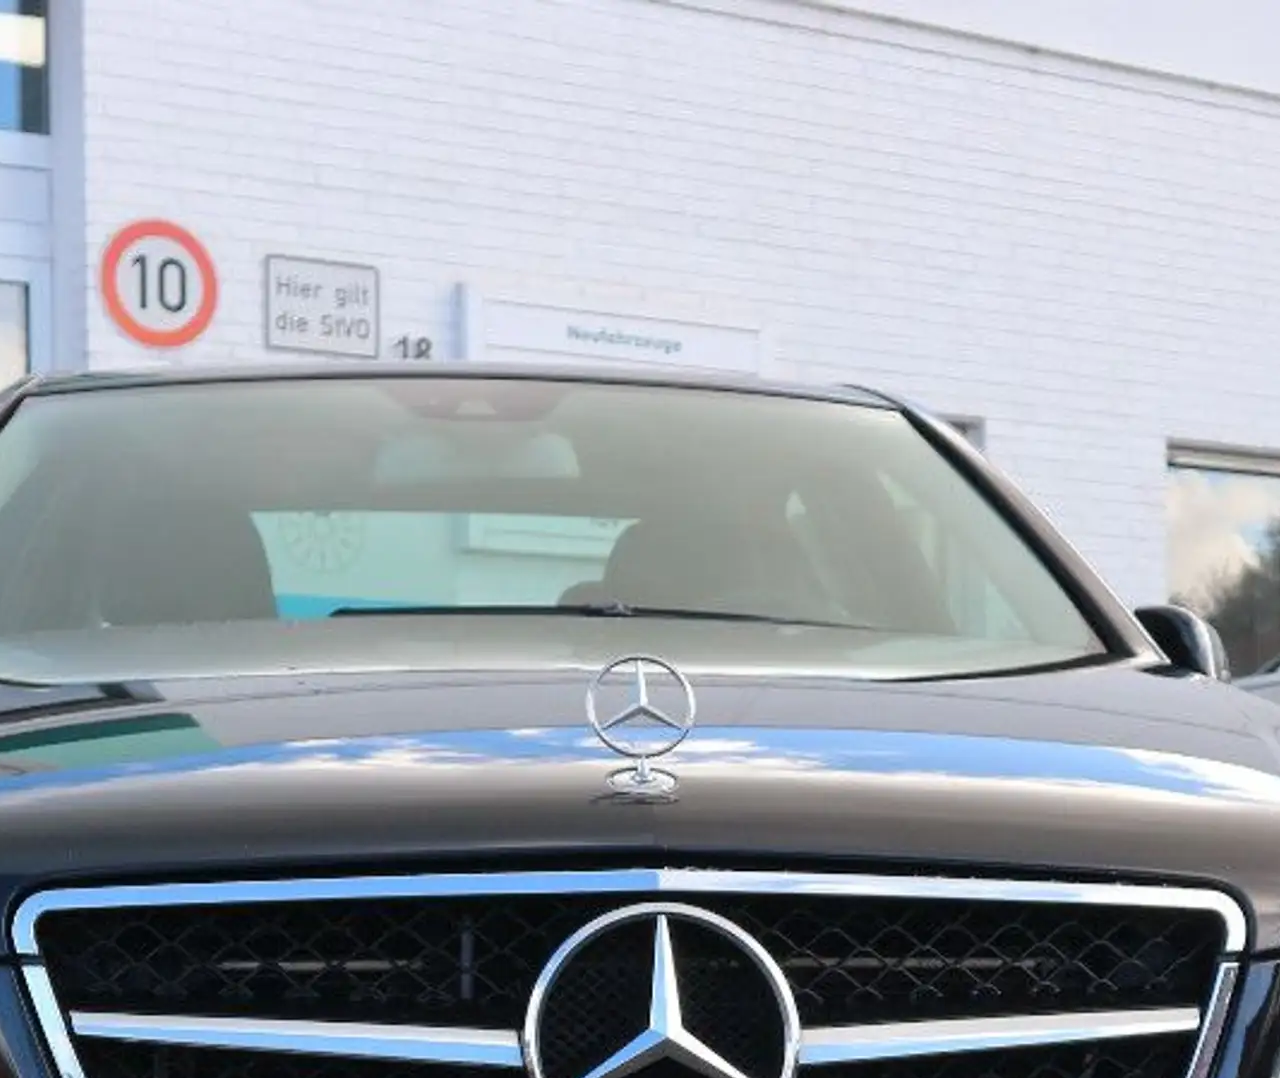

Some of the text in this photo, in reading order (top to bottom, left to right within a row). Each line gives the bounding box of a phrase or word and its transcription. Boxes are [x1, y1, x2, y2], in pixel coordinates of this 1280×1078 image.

[131, 253, 186, 313] 10
[275, 275, 370, 308] Hier gilt
[275, 312, 309, 333] die
